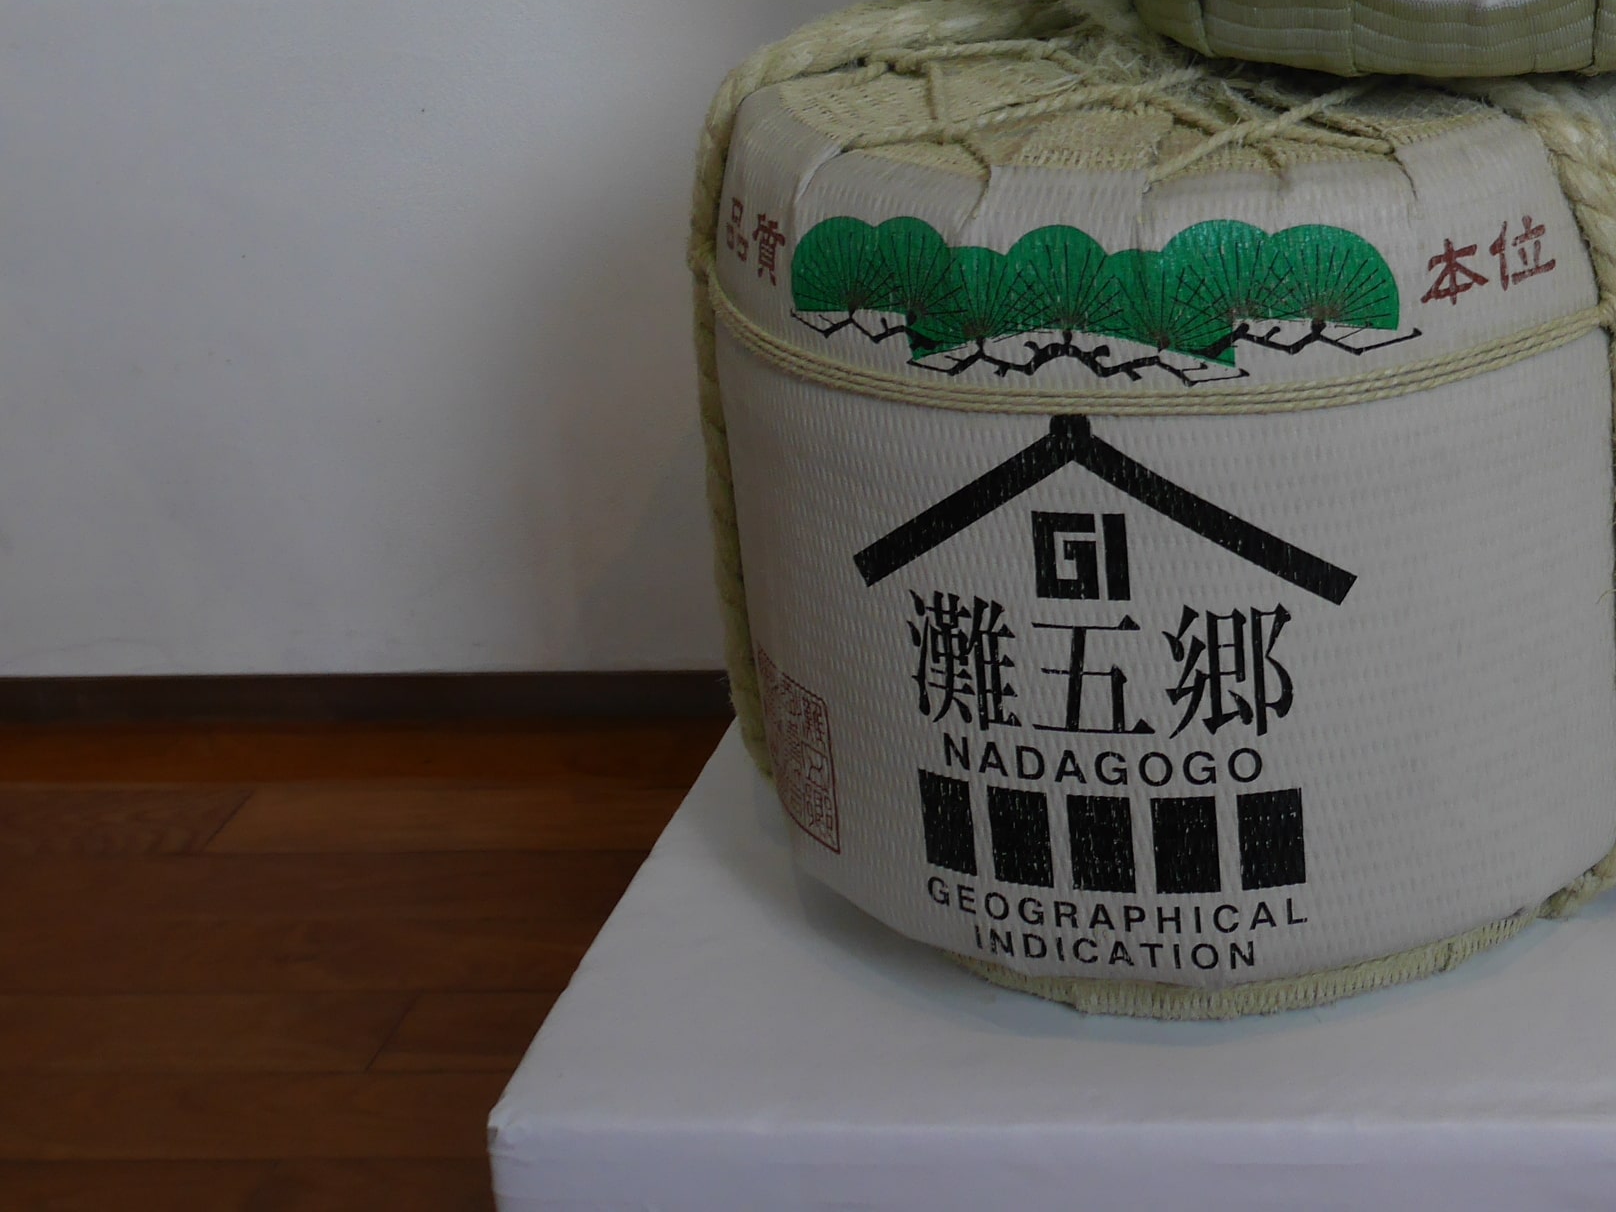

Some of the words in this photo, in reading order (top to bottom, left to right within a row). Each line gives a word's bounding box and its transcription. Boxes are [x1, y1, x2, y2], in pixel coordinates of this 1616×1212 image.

[725, 196, 786, 286] 品質
[1419, 214, 1558, 306] 本位
[1031, 511, 1131, 601] GI
[906, 589, 1295, 740] 灘五郷
[943, 732, 1264, 787] NADAGOGO
[927, 876, 1309, 935] GEOGRAPHICAL
[974, 924, 1256, 971] INDICATION
